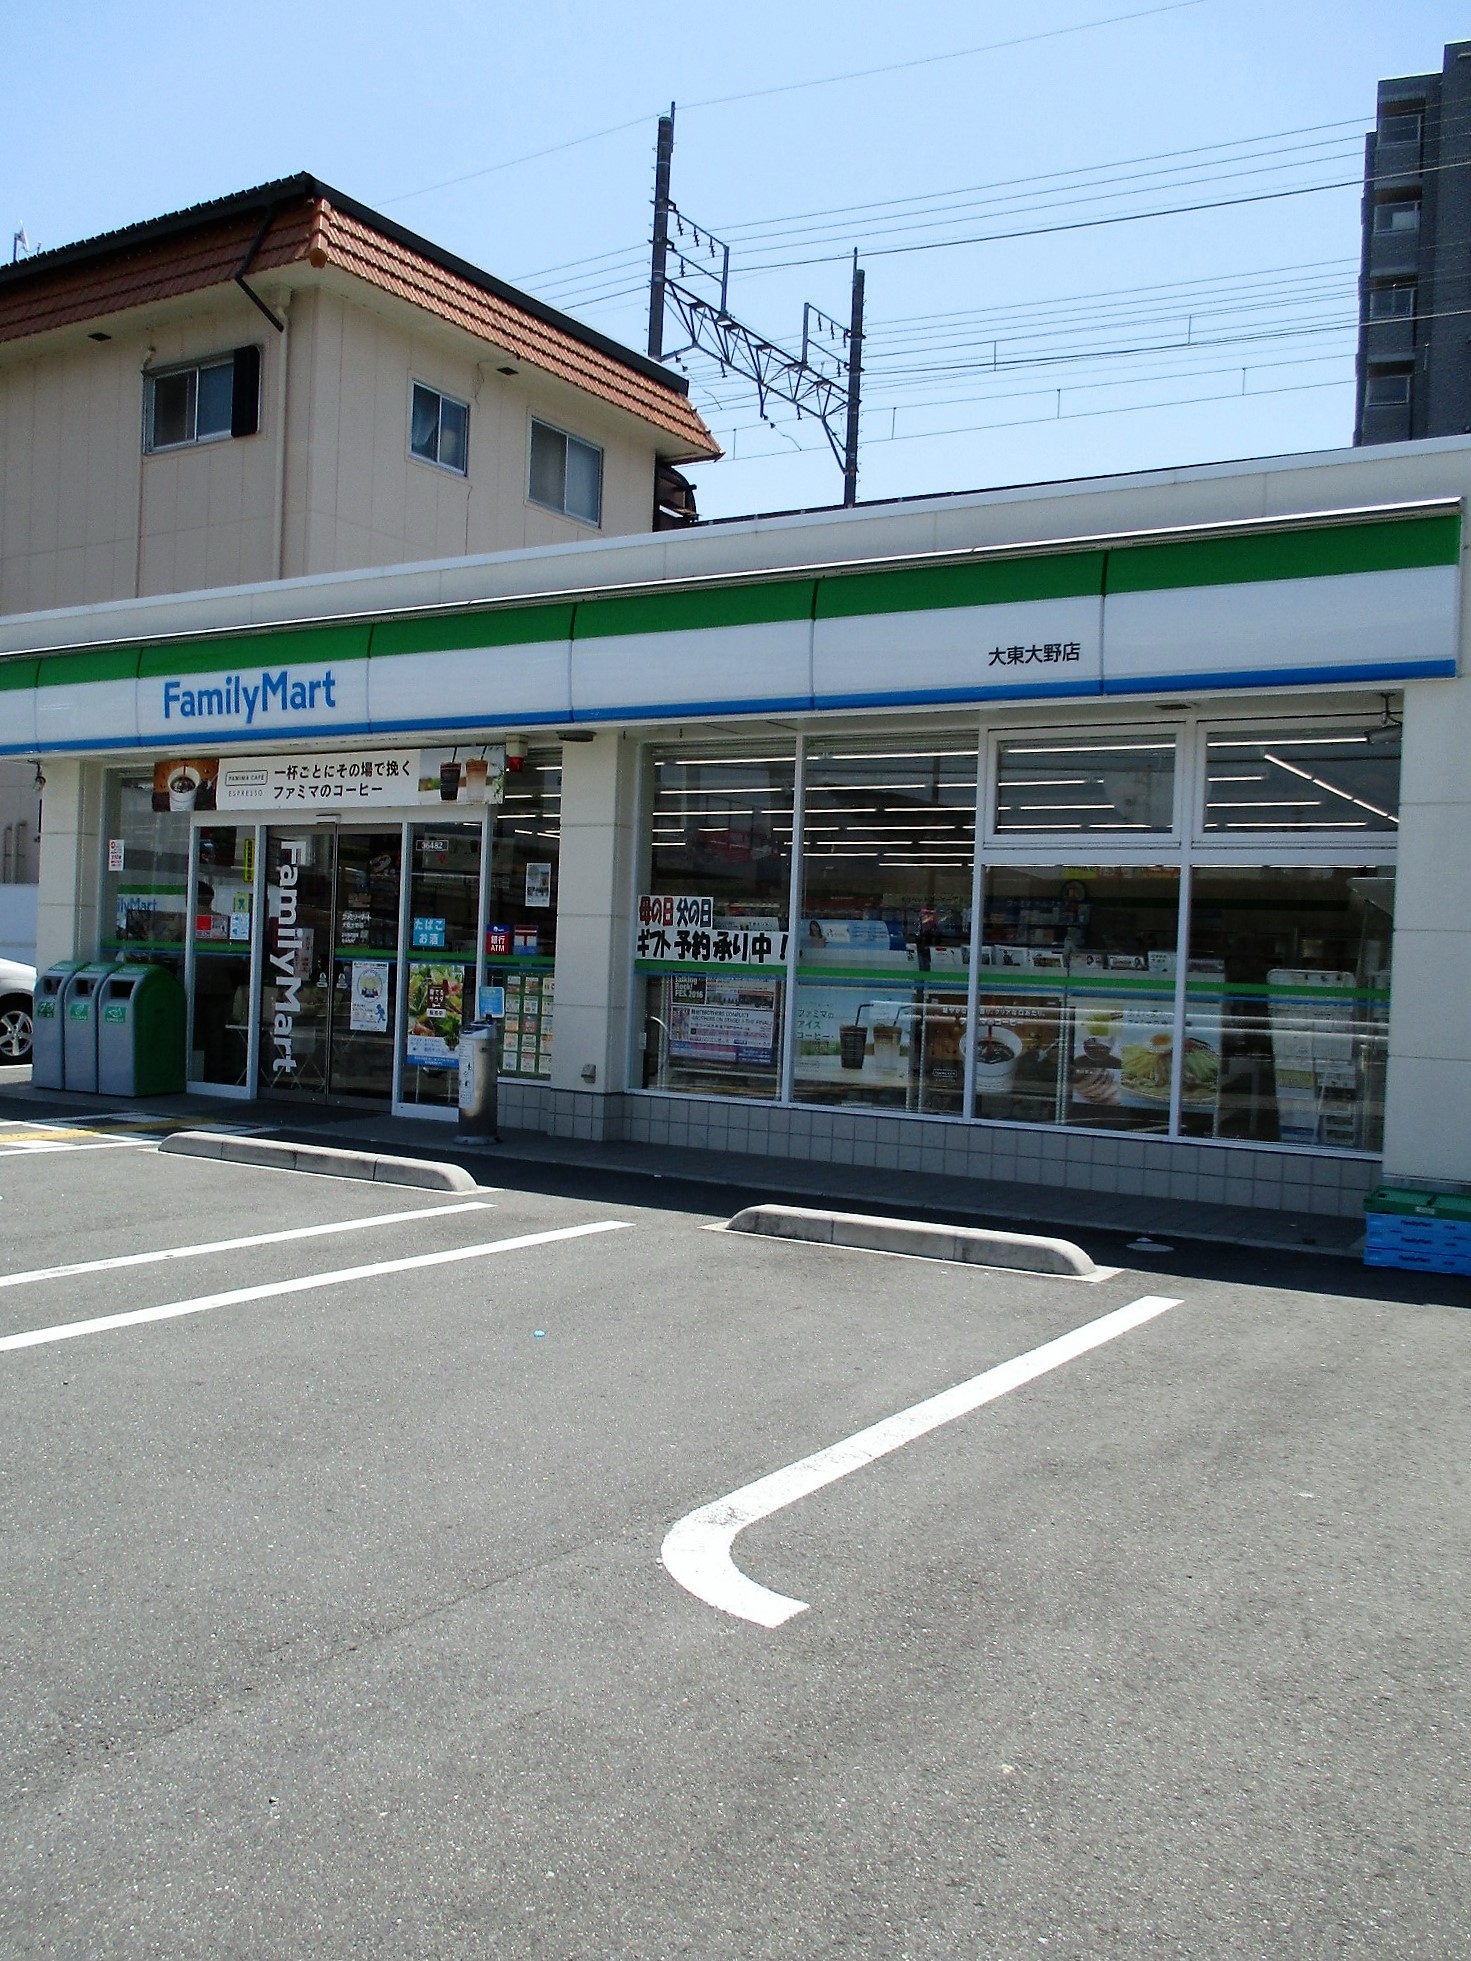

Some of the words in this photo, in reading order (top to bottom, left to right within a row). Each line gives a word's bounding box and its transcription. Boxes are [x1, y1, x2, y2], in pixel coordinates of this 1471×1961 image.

[989, 642, 1081, 666] 大東大野店
[164, 669, 336, 724] FamilyMart
[274, 760, 410, 780] 一杯ごとにその場で挽く
[228, 789, 263, 797] ESPRESSO
[273, 782, 383, 799] ファミマのコーヒー
[639, 895, 674, 926] 母の日
[676, 897, 712, 928] 父の日
[414, 918, 443, 931] たばこ
[418, 933, 439, 945] お酒
[490, 935, 506, 945] 銀行
[490, 944, 505, 952] ATM
[269, 841, 307, 1072] FamilyMart
[797, 1008, 834, 1019] ファミマの
[797, 1020, 821, 1029] アイス
